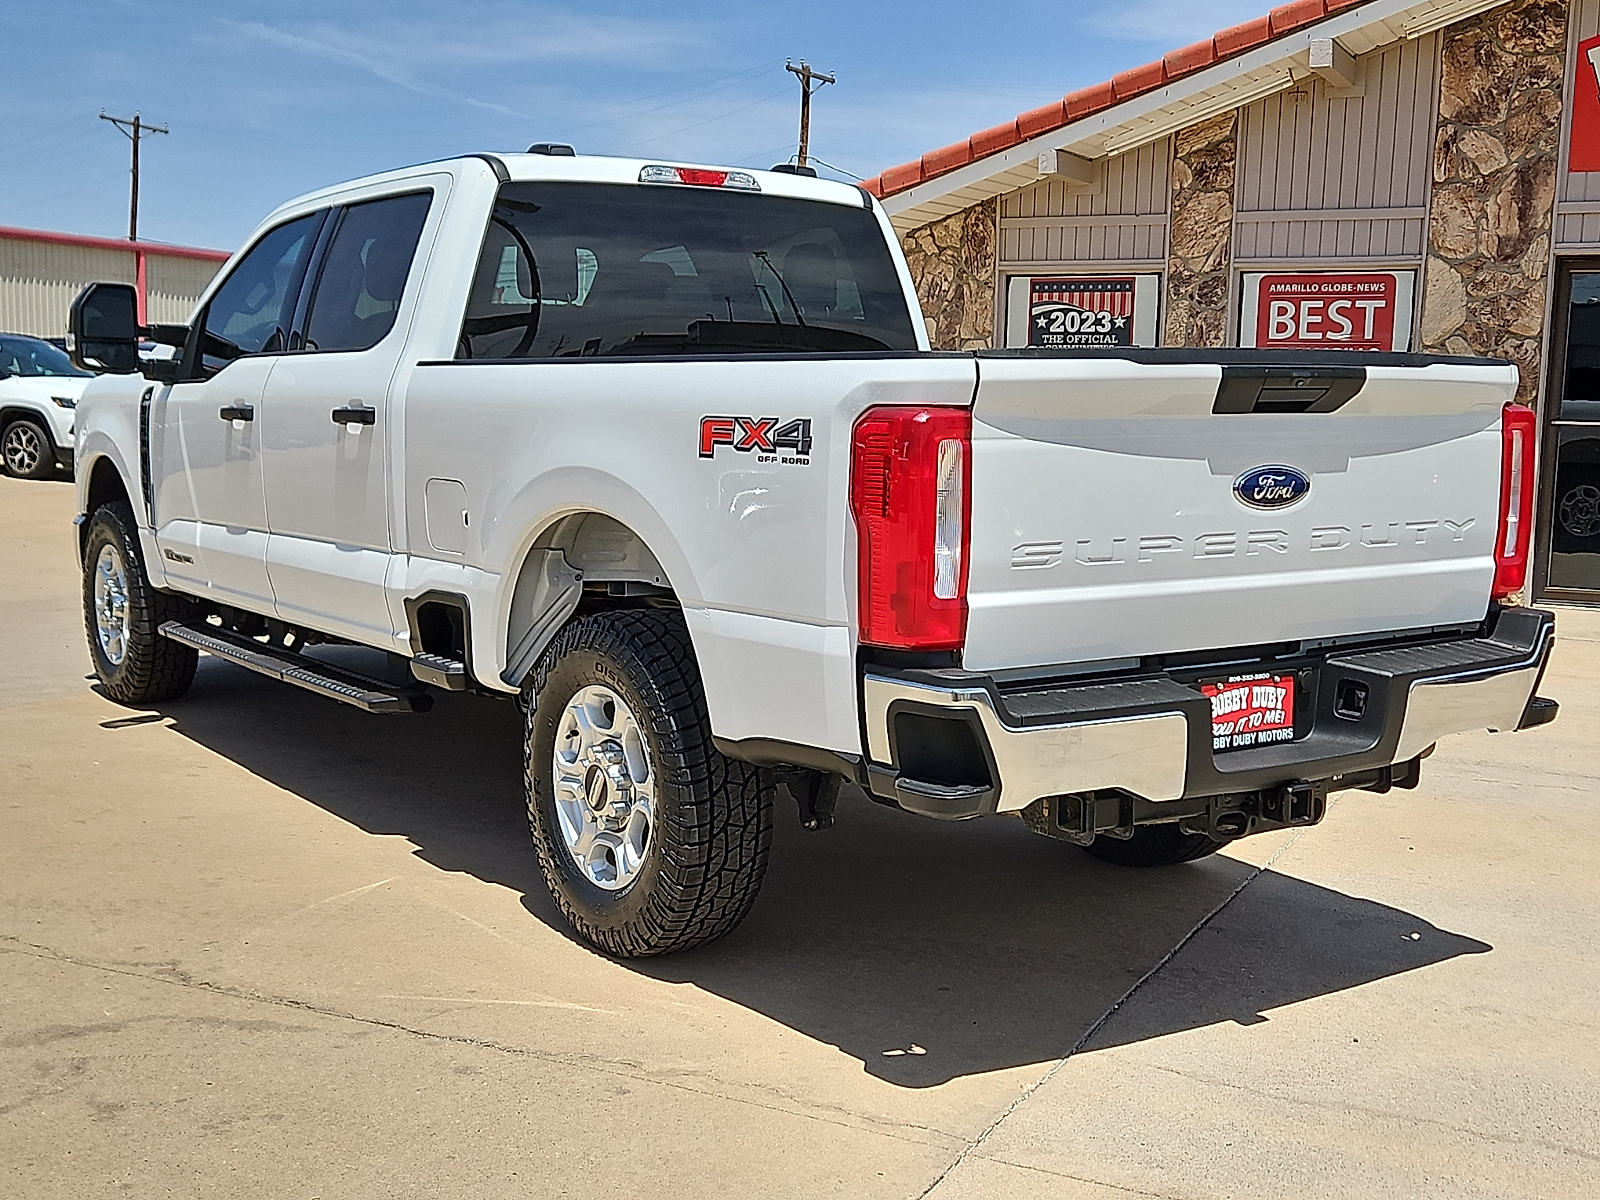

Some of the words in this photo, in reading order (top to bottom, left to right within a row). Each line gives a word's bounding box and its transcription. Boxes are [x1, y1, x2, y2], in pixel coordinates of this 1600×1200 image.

[1269, 283, 1319, 293] AMARILLO
[1321, 282, 1386, 292] GLOBE-NEWS
[1049, 311, 1112, 333] 2023
[1268, 300, 1387, 340] BEST
[1042, 334, 1064, 344] THE
[1066, 334, 1119, 344] OFFICIAL
[698, 414, 813, 460] FX4
[757, 455, 778, 464] OFF
[781, 456, 811, 466] ROAD
[1253, 474, 1296, 500] Ford
[1010, 530, 1289, 571] SUPER
[1310, 517, 1476, 552] DUTY
[1252, 686, 1286, 710] DUBY
[1235, 716, 1249, 733] IT
[1248, 711, 1263, 729] TO
[1264, 709, 1285, 724] ME!
[1233, 732, 1256, 747] DUBY
[1258, 728, 1293, 743] MOTORS
